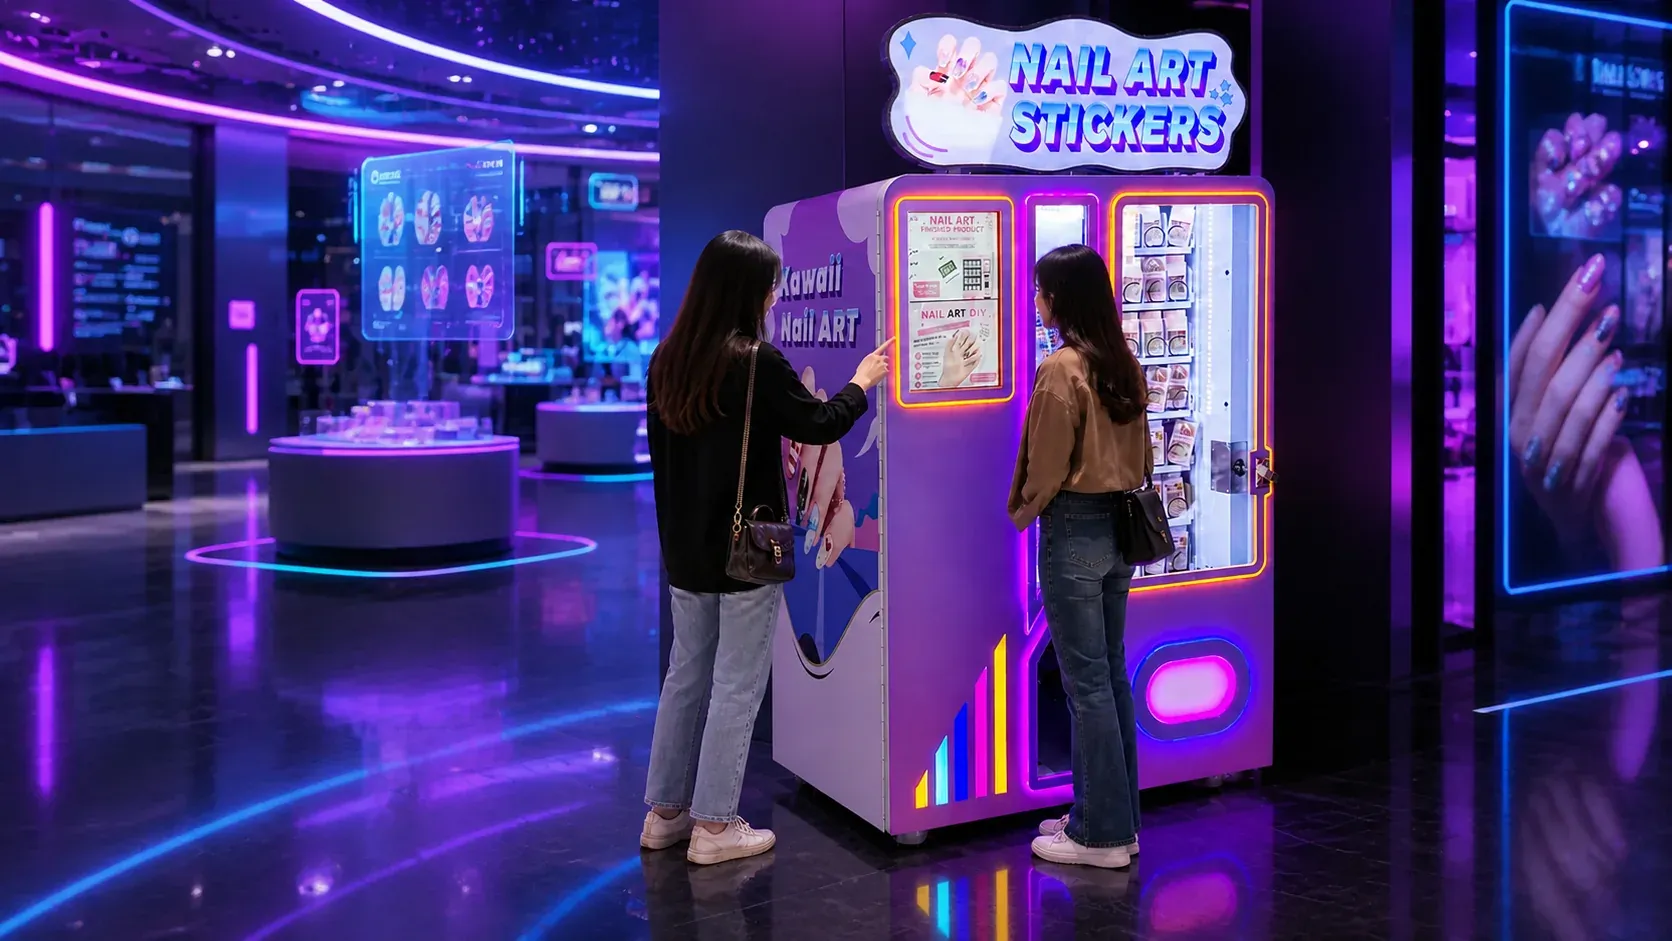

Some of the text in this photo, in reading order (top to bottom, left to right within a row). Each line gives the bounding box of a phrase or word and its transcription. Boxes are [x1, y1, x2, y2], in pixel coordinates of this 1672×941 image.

[1009, 41, 1218, 98] NAIL ART
[1009, 99, 1227, 154] STICKERS
[929, 215, 975, 225] NAIL ART
[781, 252, 844, 302] Kawaii
[781, 306, 862, 349] Nail ART
[921, 308, 987, 319] NAIL ART DIY
